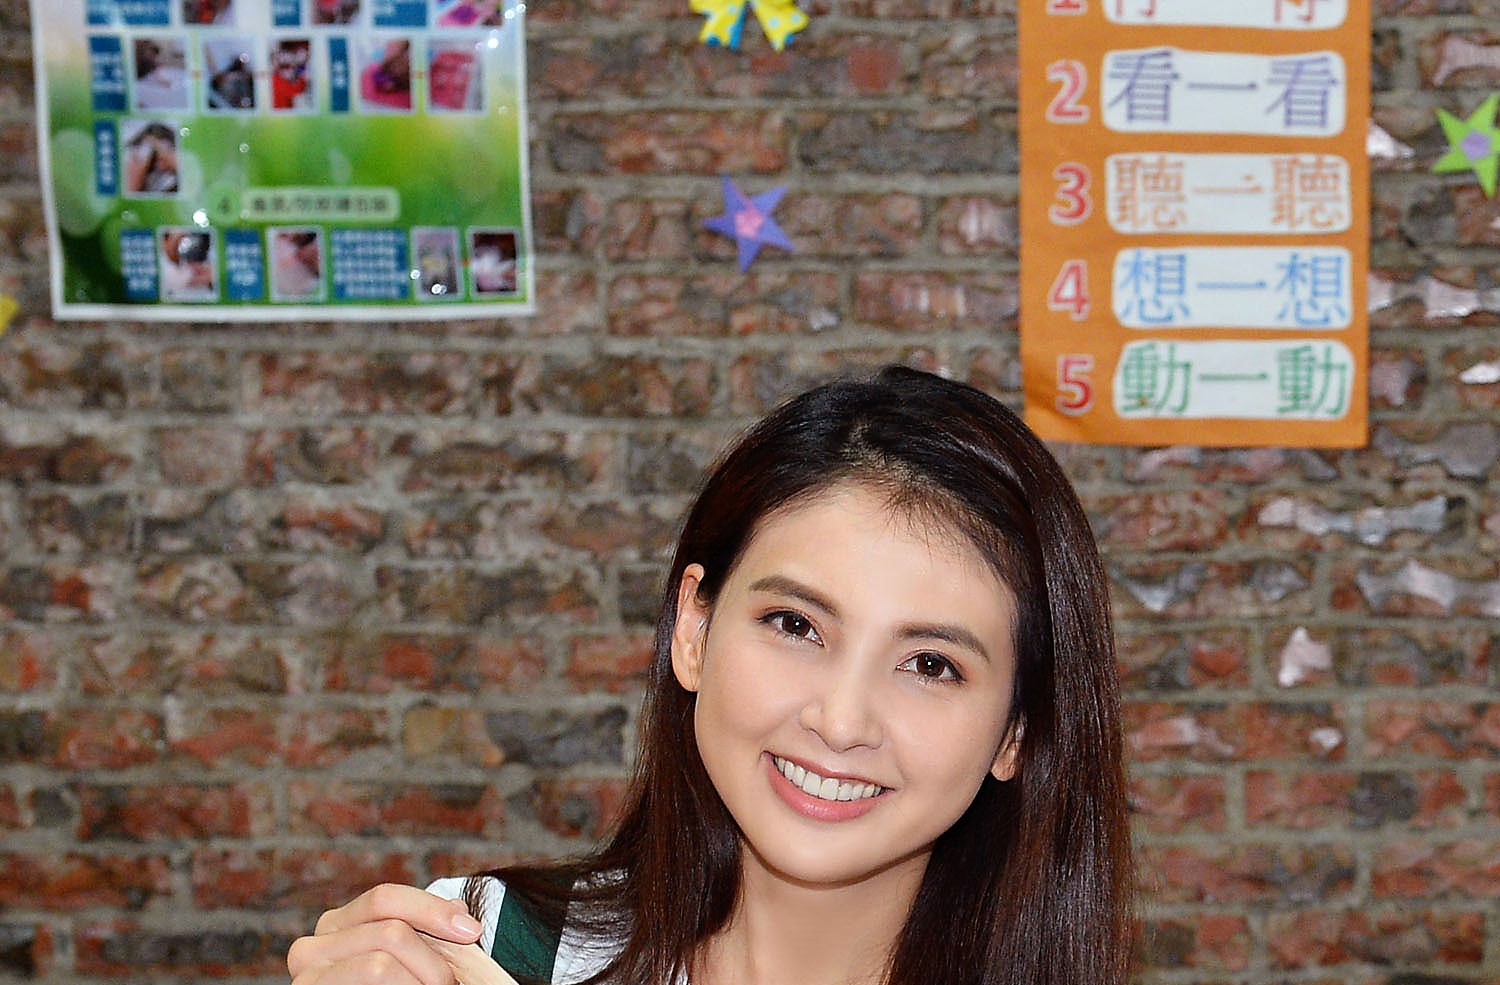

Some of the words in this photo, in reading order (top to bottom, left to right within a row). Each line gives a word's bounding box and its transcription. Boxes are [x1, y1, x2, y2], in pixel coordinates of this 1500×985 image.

[1048, 60, 1089, 122] 2
[1108, 50, 1338, 129] 看一看
[1050, 162, 1092, 225] 3
[1114, 155, 1345, 230] 聽一聽
[1049, 260, 1088, 320] 4
[1119, 250, 1348, 326] 想一想
[1058, 354, 1094, 415] 5
[1121, 343, 1348, 415] 動一動
